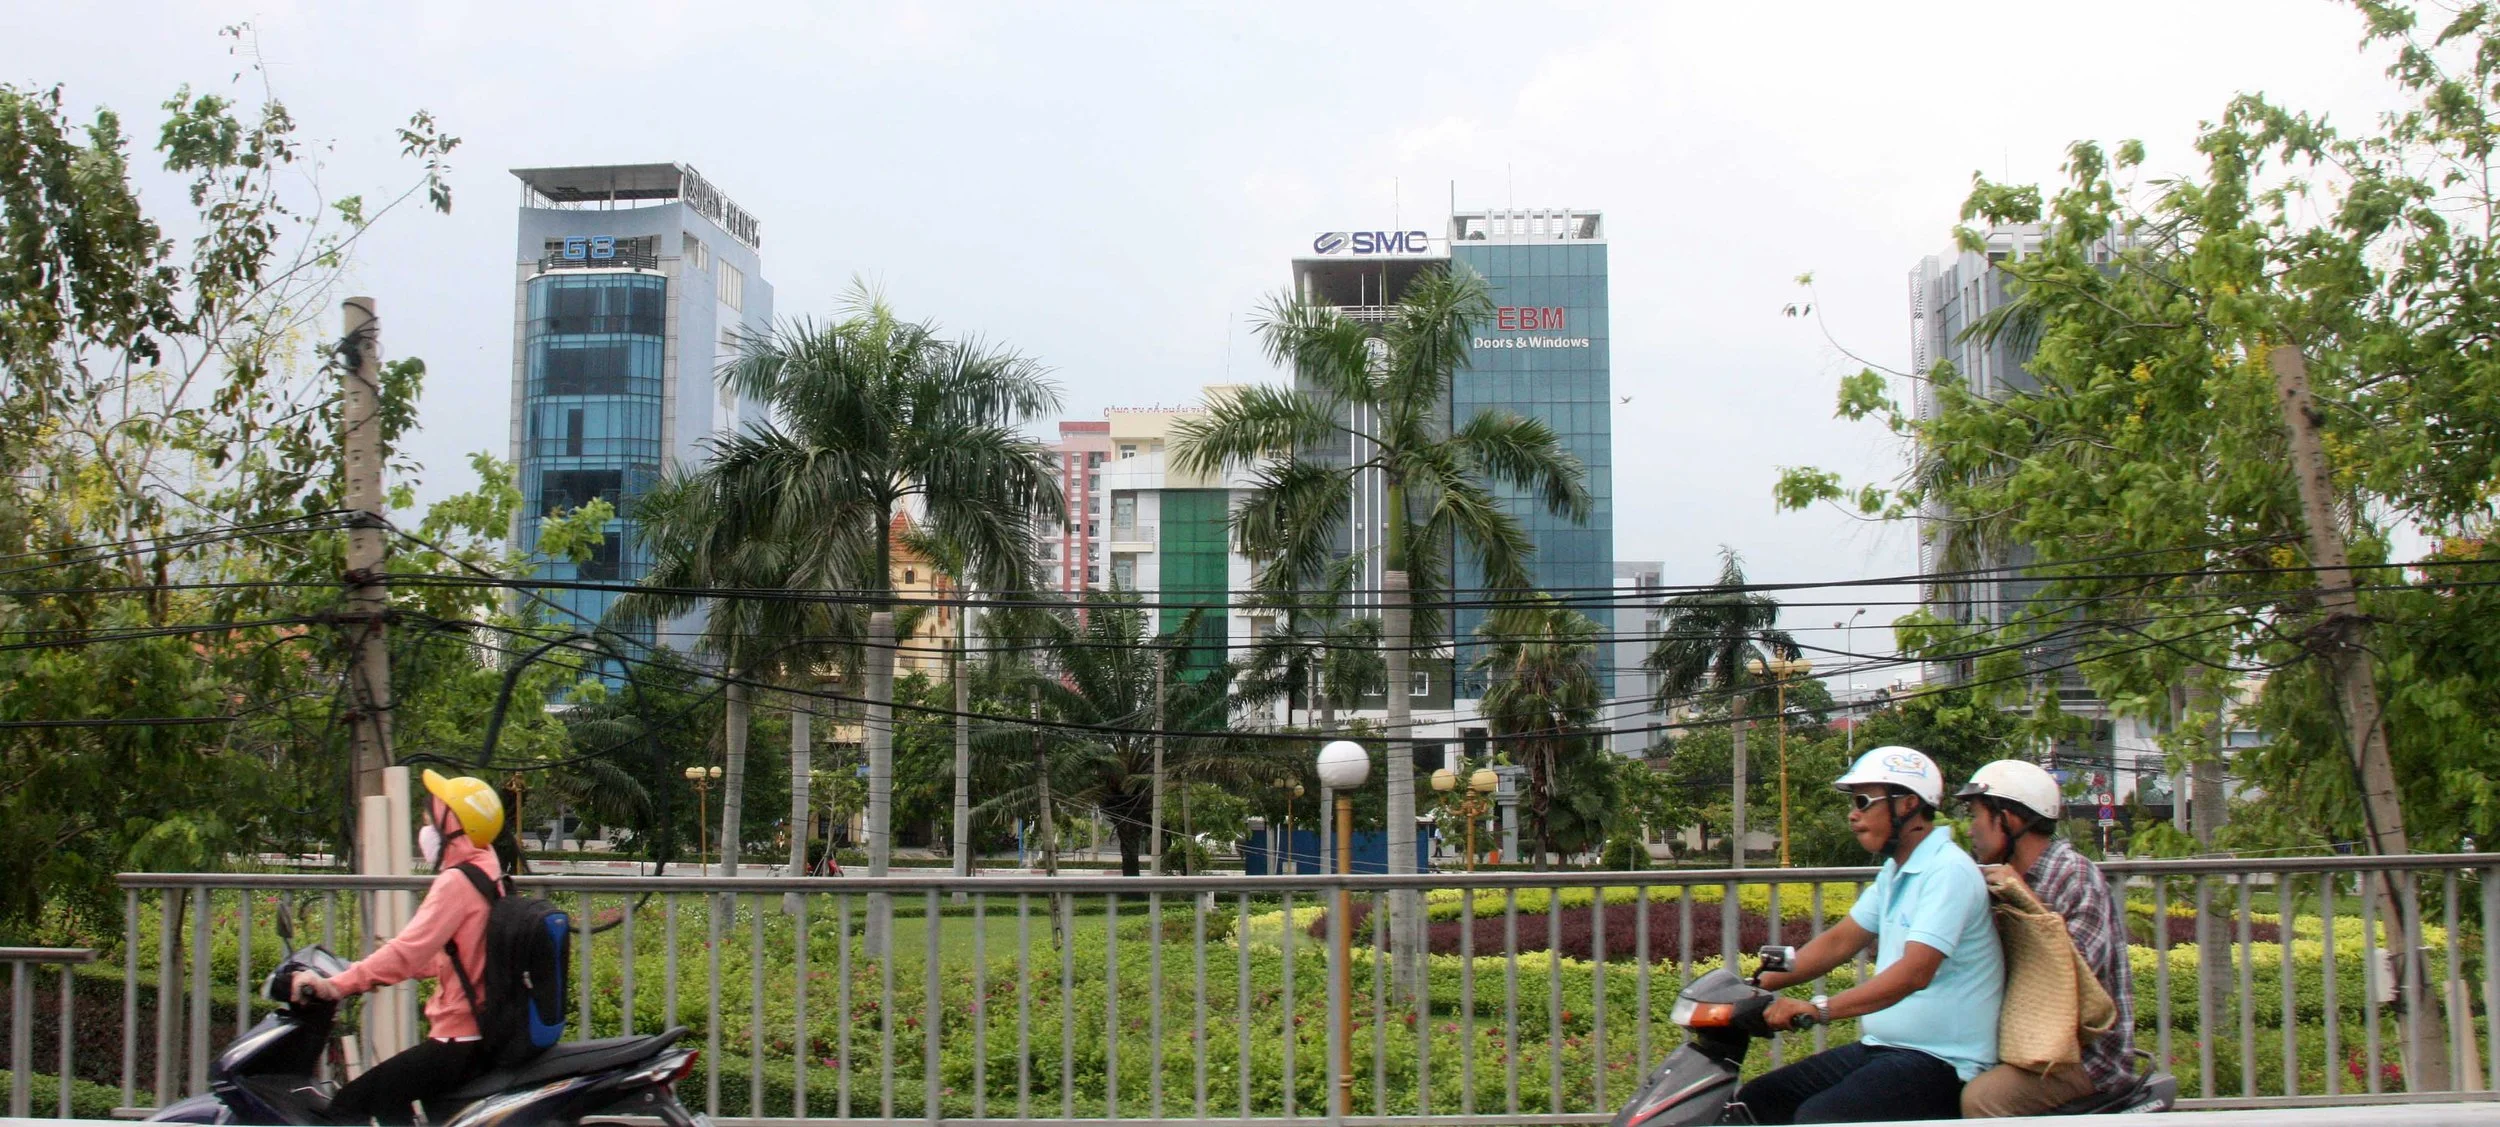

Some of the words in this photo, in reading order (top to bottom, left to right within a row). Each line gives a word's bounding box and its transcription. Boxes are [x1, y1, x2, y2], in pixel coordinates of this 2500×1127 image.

[1352, 231, 1427, 254] SMC
[1497, 306, 1565, 331] EBM
[1473, 337, 1513, 349] Doors
[1516, 336, 1527, 349] &
[1528, 335, 1589, 348] Windows
